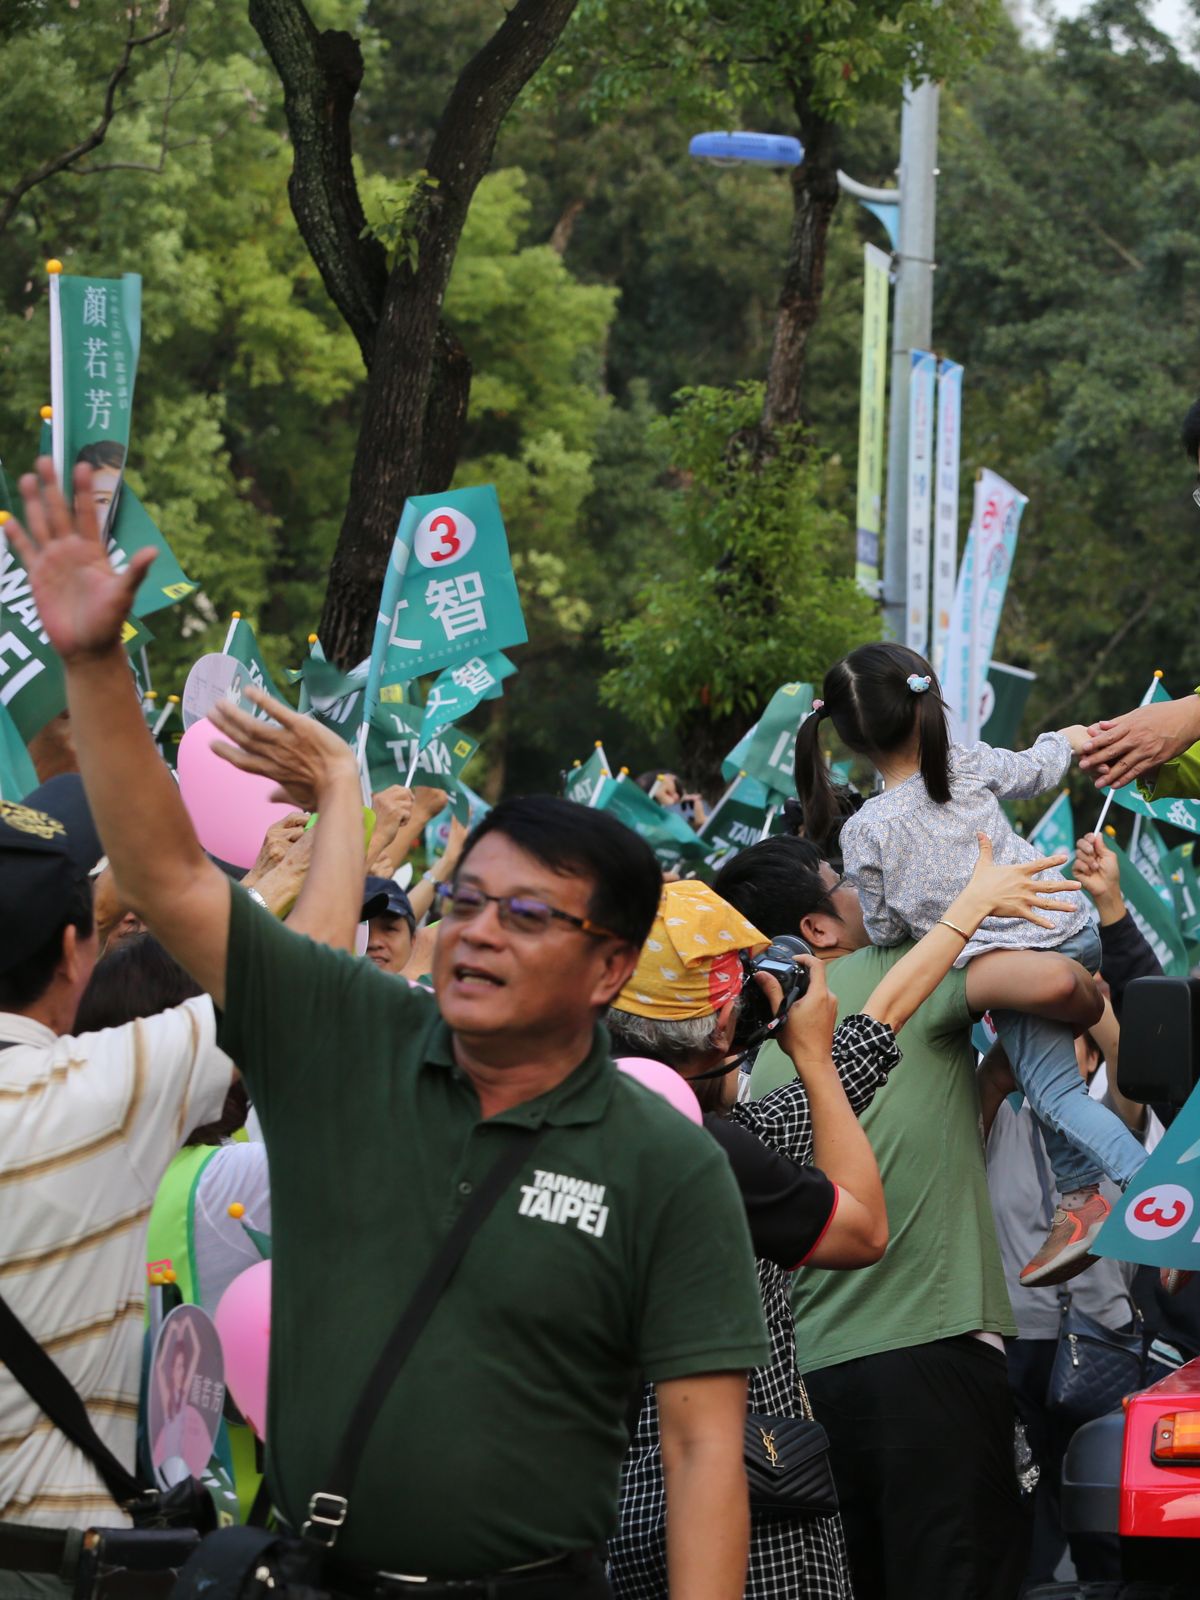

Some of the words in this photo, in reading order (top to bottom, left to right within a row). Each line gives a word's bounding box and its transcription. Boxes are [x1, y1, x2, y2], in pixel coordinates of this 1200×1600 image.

[83, 286, 112, 430] 顏若芳
[430, 515, 461, 562] 3
[534, 1169, 606, 1204] TAIWAN
[518, 1185, 610, 1239] TAIPEI
[1133, 1197, 1187, 1229] 3
